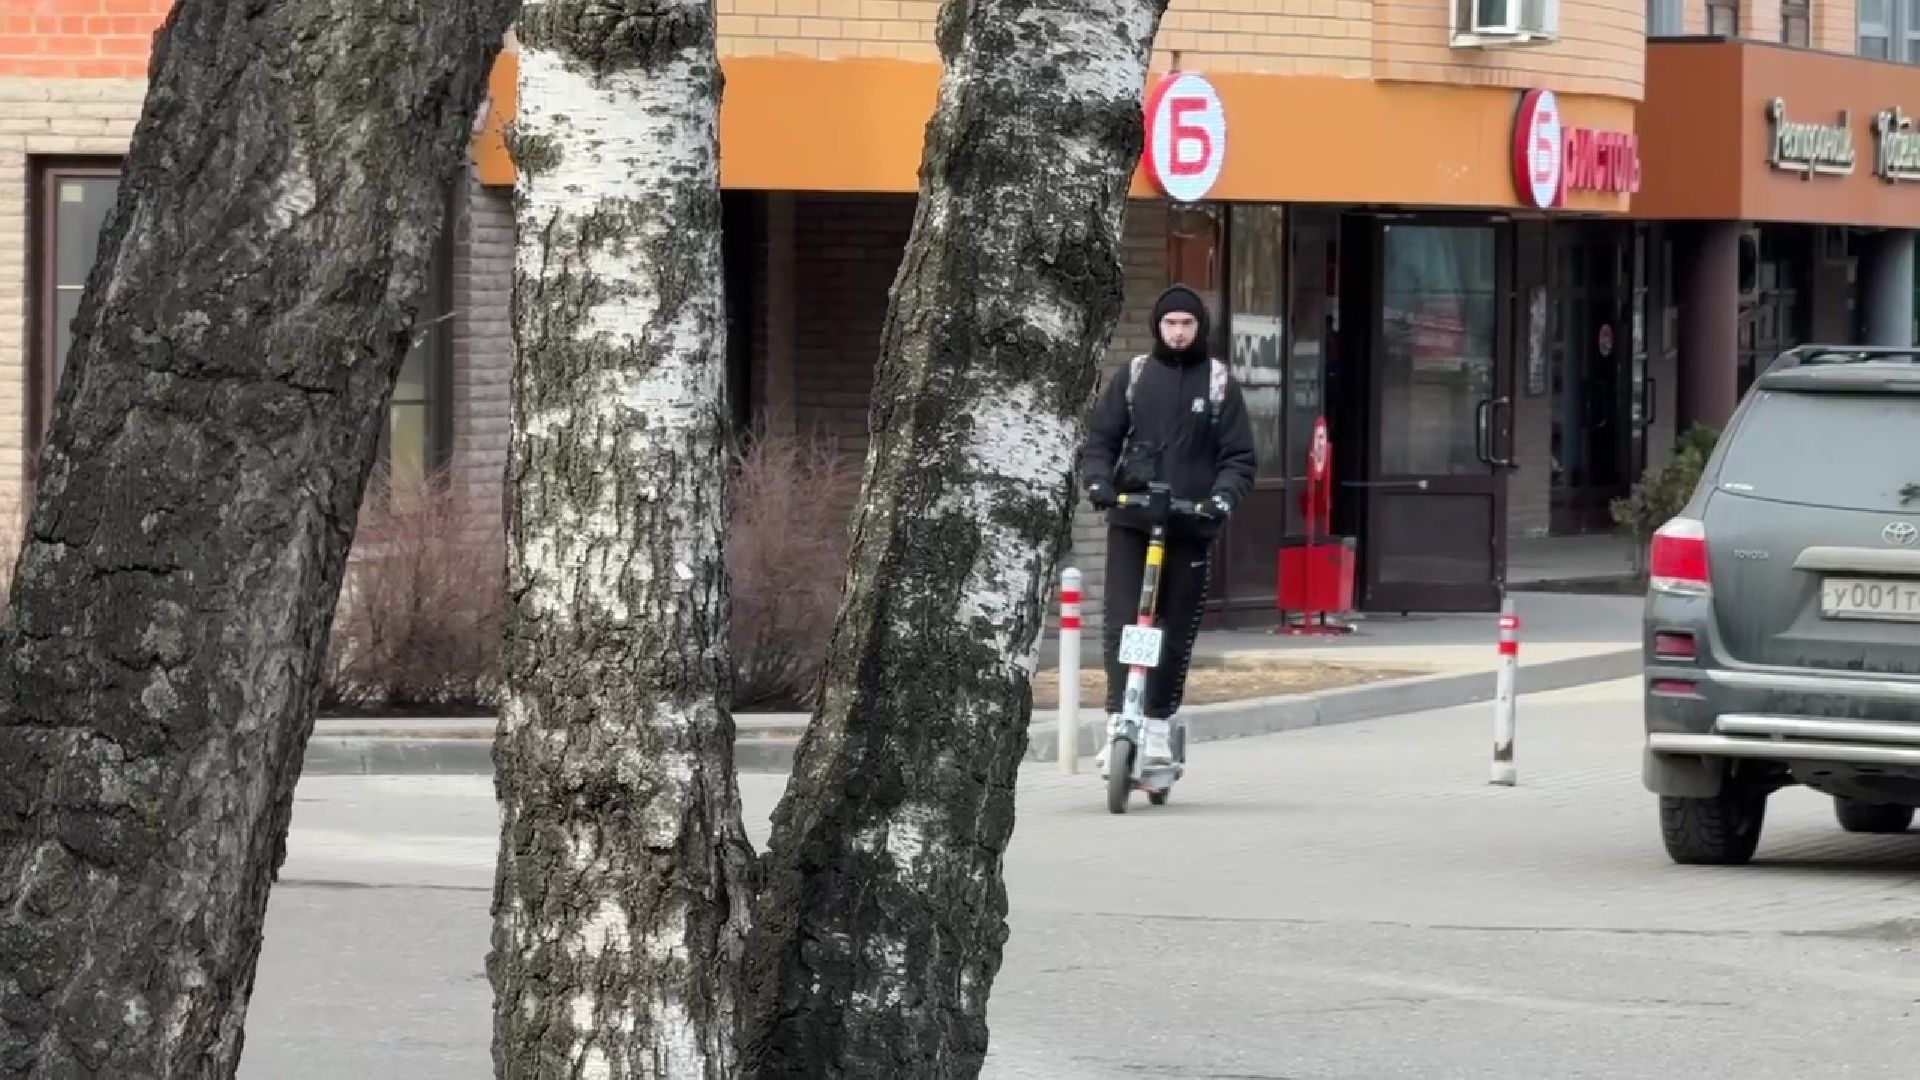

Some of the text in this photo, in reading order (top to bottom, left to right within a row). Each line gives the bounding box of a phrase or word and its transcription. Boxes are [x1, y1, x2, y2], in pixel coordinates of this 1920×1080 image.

[1169, 97, 1212, 175] Б
[1734, 549, 1770, 560] TOYOTA
[1833, 583, 1920, 611] У001Т
